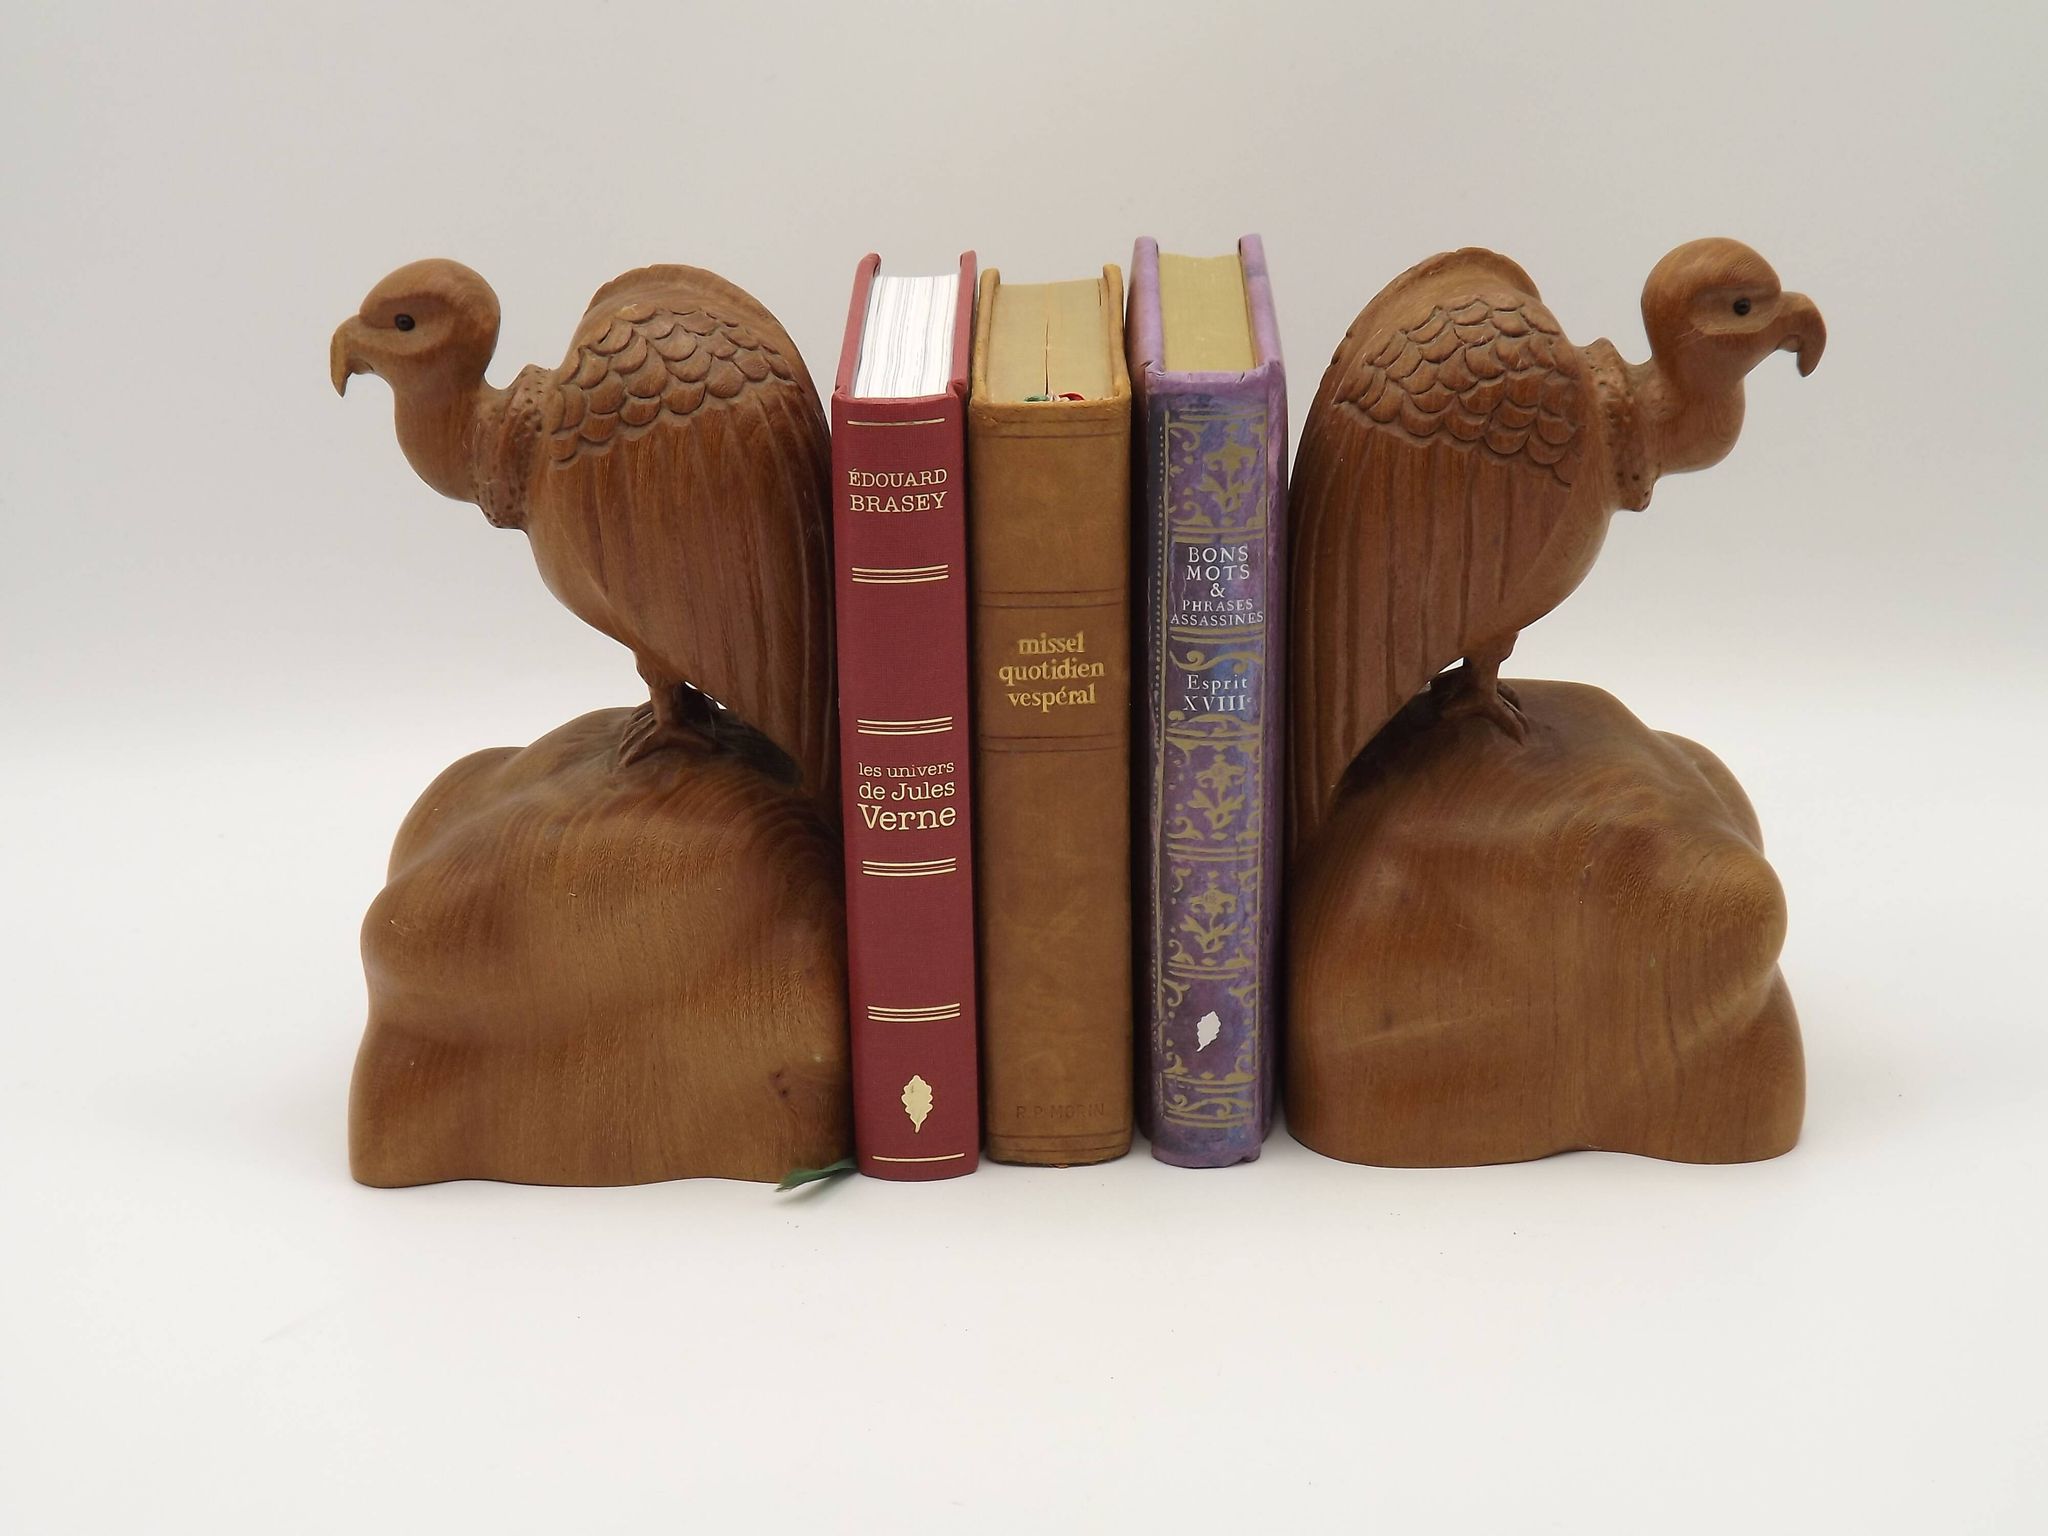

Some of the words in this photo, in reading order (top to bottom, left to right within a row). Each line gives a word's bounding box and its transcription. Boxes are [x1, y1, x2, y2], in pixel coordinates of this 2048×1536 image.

[848, 468, 947, 488] ÉDOUARD
[850, 491, 948, 512] BRASEY
[1188, 544, 1249, 563] BONS
[1186, 564, 1250, 581] MOTS
[1210, 583, 1226, 598] &
[1182, 599, 1253, 612] PHRASES
[1170, 611, 1264, 627] ASSASSINES
[1017, 630, 1085, 655] missel
[999, 657, 1105, 687] quotidien
[1187, 674, 1248, 695] Esprit
[1006, 682, 1096, 713] vespéral
[858, 762, 882, 777] les
[886, 762, 955, 778] univers
[859, 782, 886, 800] de
[891, 781, 955, 800] Jules
[857, 803, 956, 831] Verne
